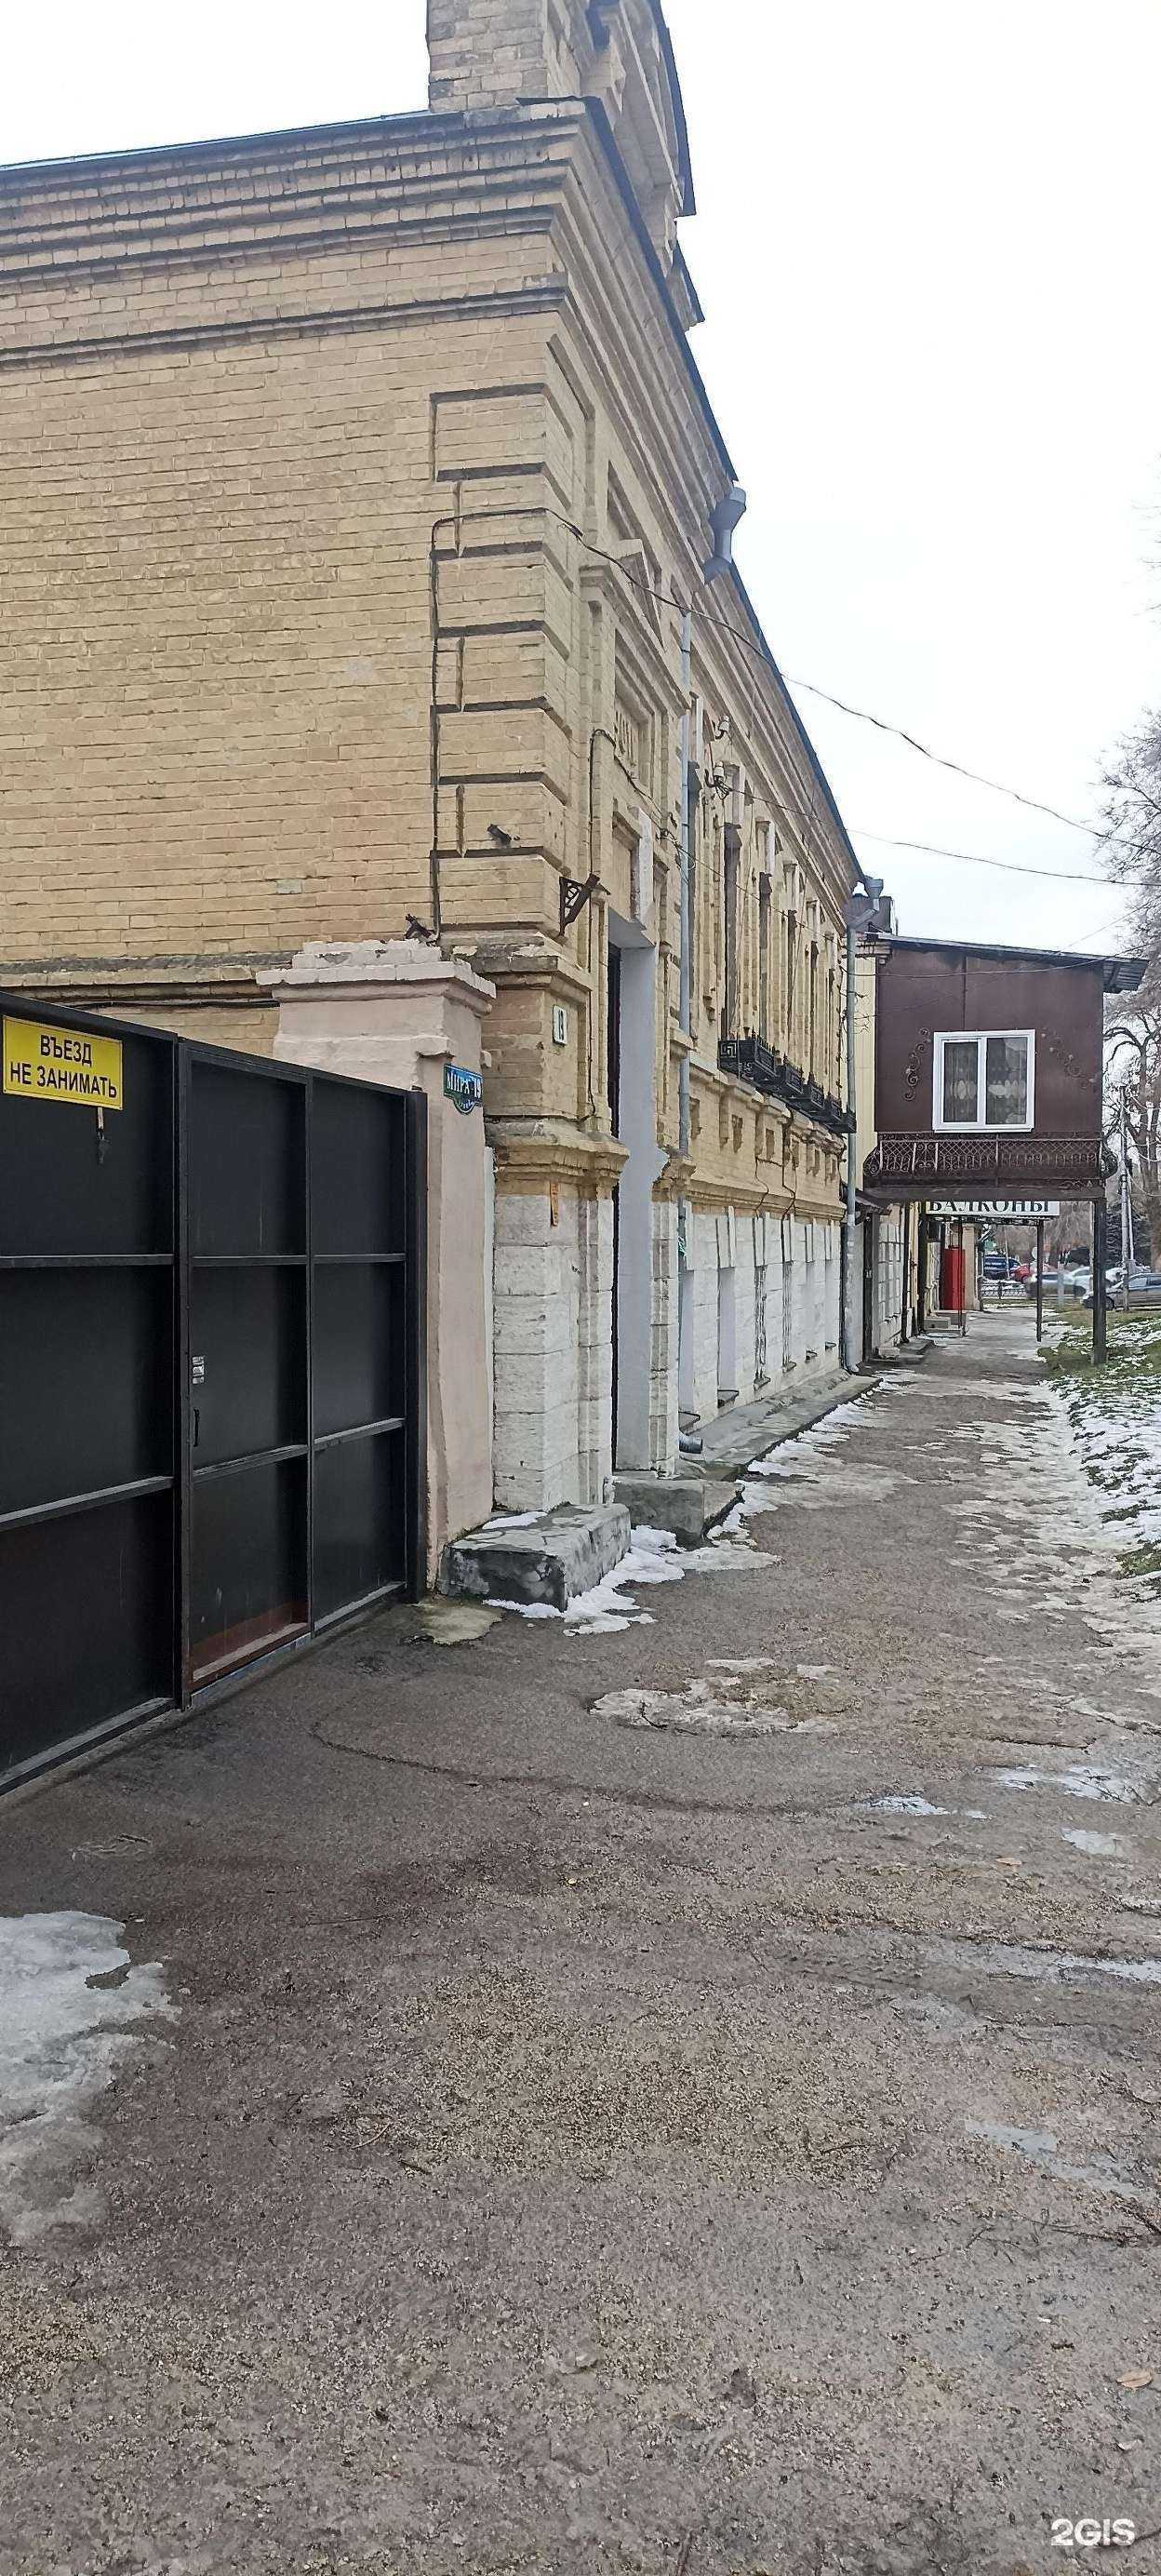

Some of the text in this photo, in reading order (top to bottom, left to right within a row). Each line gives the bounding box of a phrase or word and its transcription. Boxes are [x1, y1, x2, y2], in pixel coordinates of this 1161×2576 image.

[40, 1035, 92, 1067] ВЪЕЗД
[10, 1062, 117, 1098] НЕ ЗАНИМАТЬ
[447, 1072, 470, 1093] МИРА
